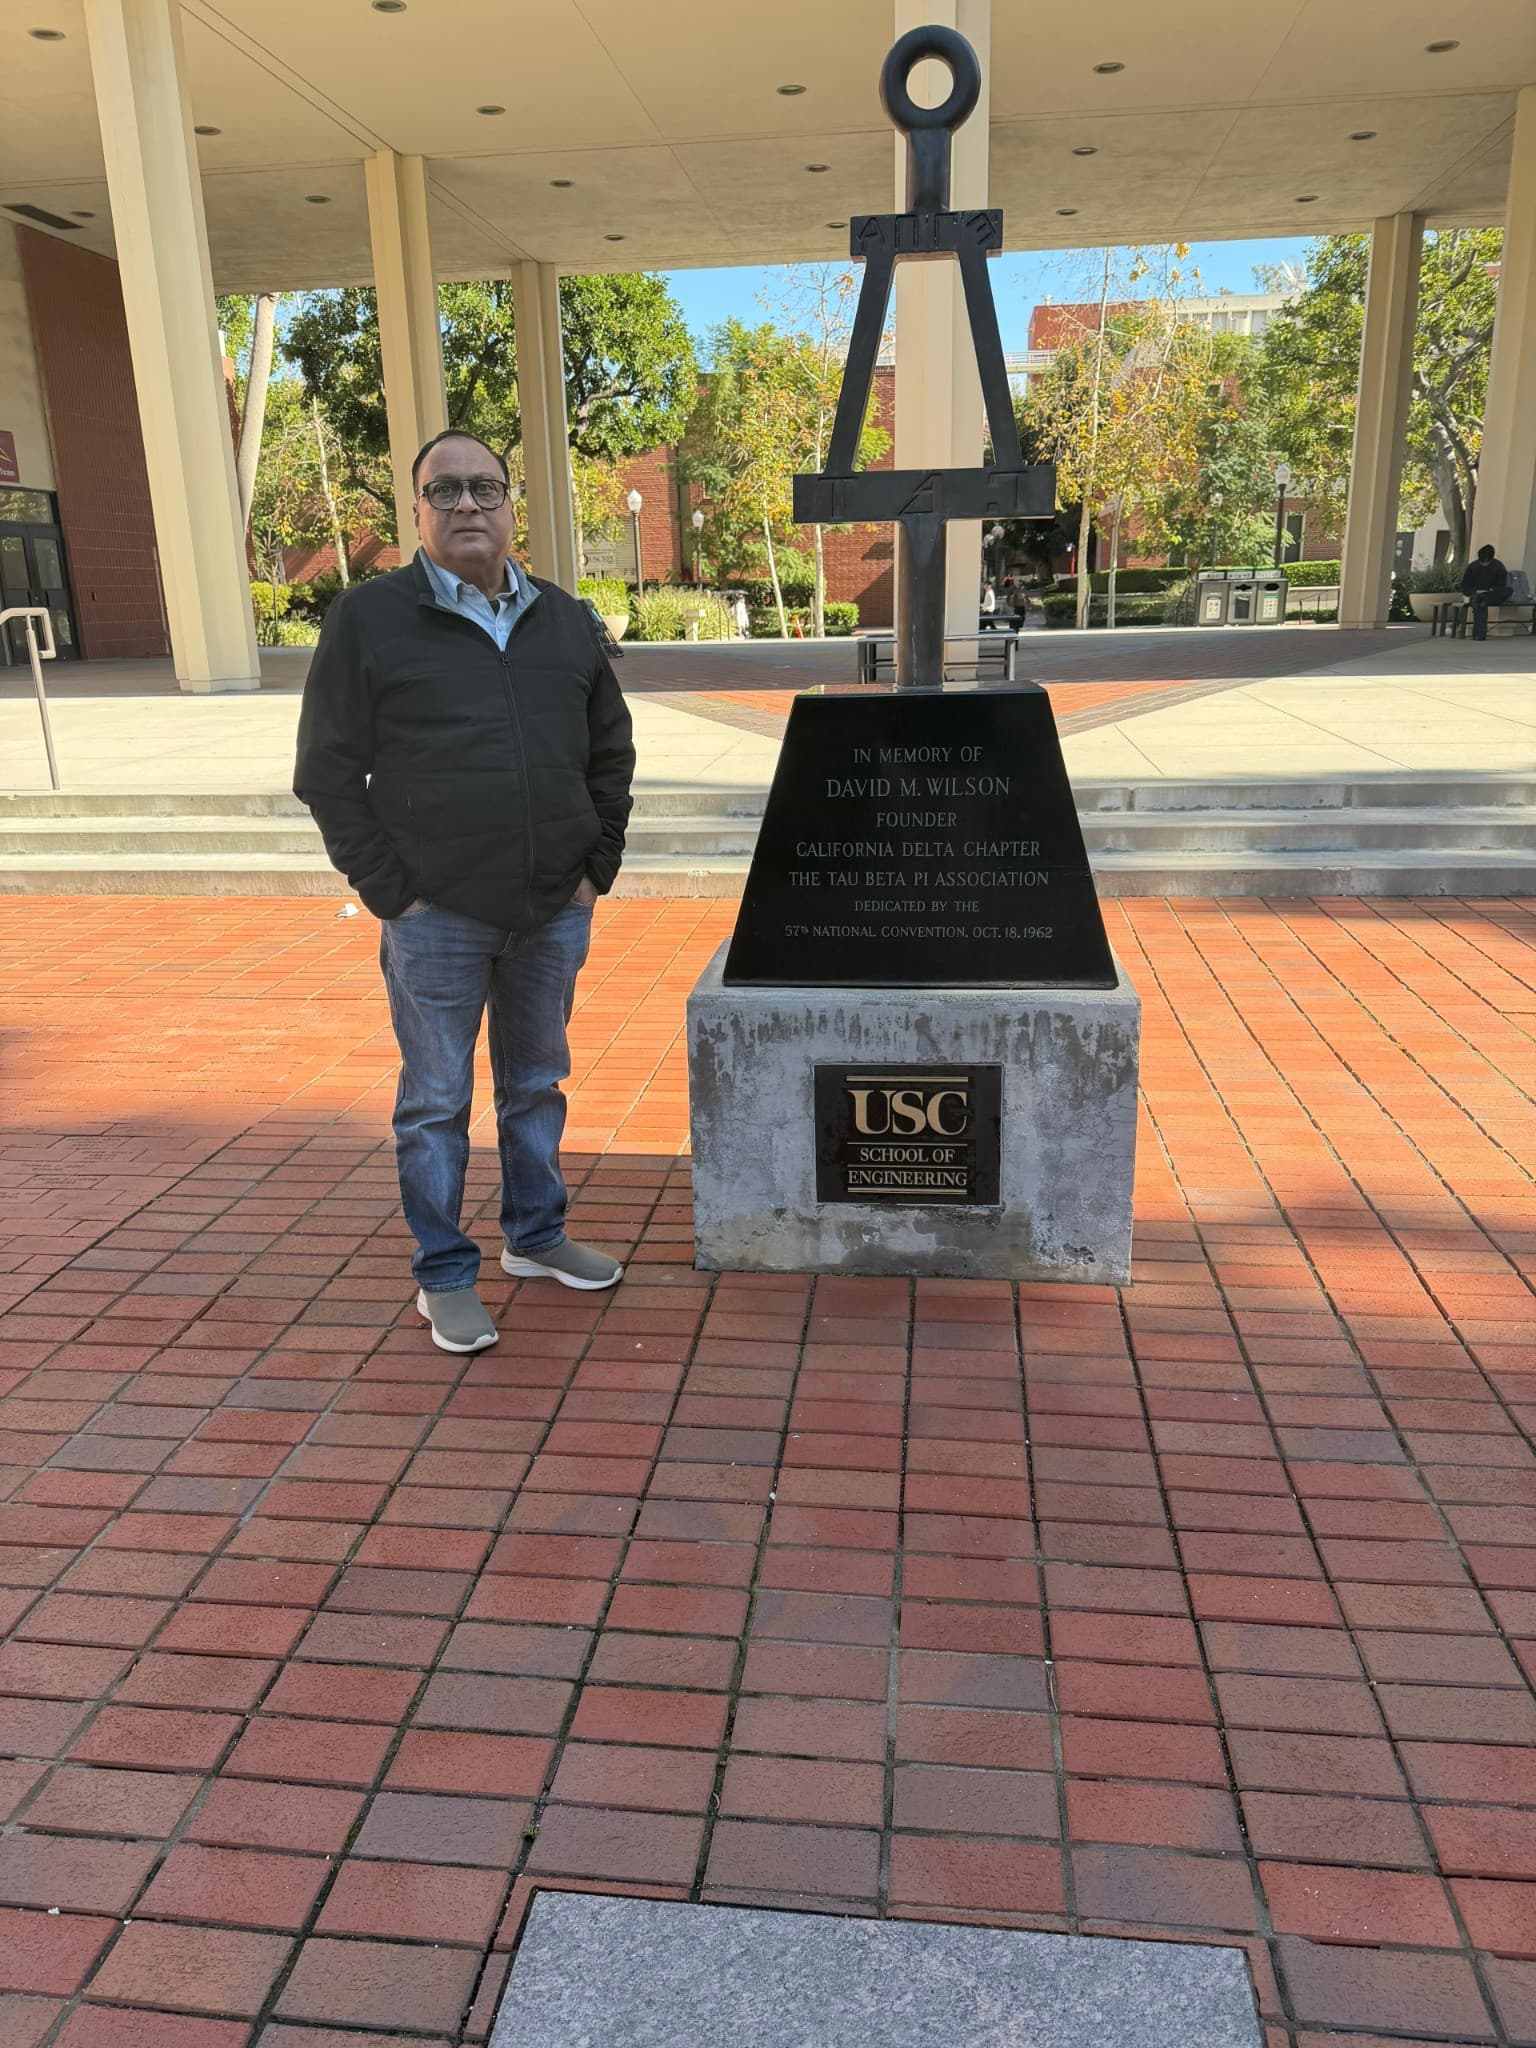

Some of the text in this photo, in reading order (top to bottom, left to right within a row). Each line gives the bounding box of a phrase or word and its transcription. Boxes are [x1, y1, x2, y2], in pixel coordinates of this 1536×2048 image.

[854, 747, 982, 762] IN MEMORY OF
[826, 777, 1010, 798] DAVID M. WILSON
[877, 812, 957, 827] FOUNDER
[796, 841, 1040, 857] CALIFORNIA DELTA CHAPTER
[789, 872, 1048, 886] THE TAU BETA PI ASSOCIATION
[856, 901, 979, 912] DEDICATED BY THE
[813, 926, 876, 936] NATIONAL
[972, 926, 1001, 938] OCT.
[1024, 927, 1053, 938] 1962
[848, 1090, 967, 1135] USC
[860, 1148, 955, 1163] SCHOOL OF
[848, 1171, 967, 1185] ENGINEERING
